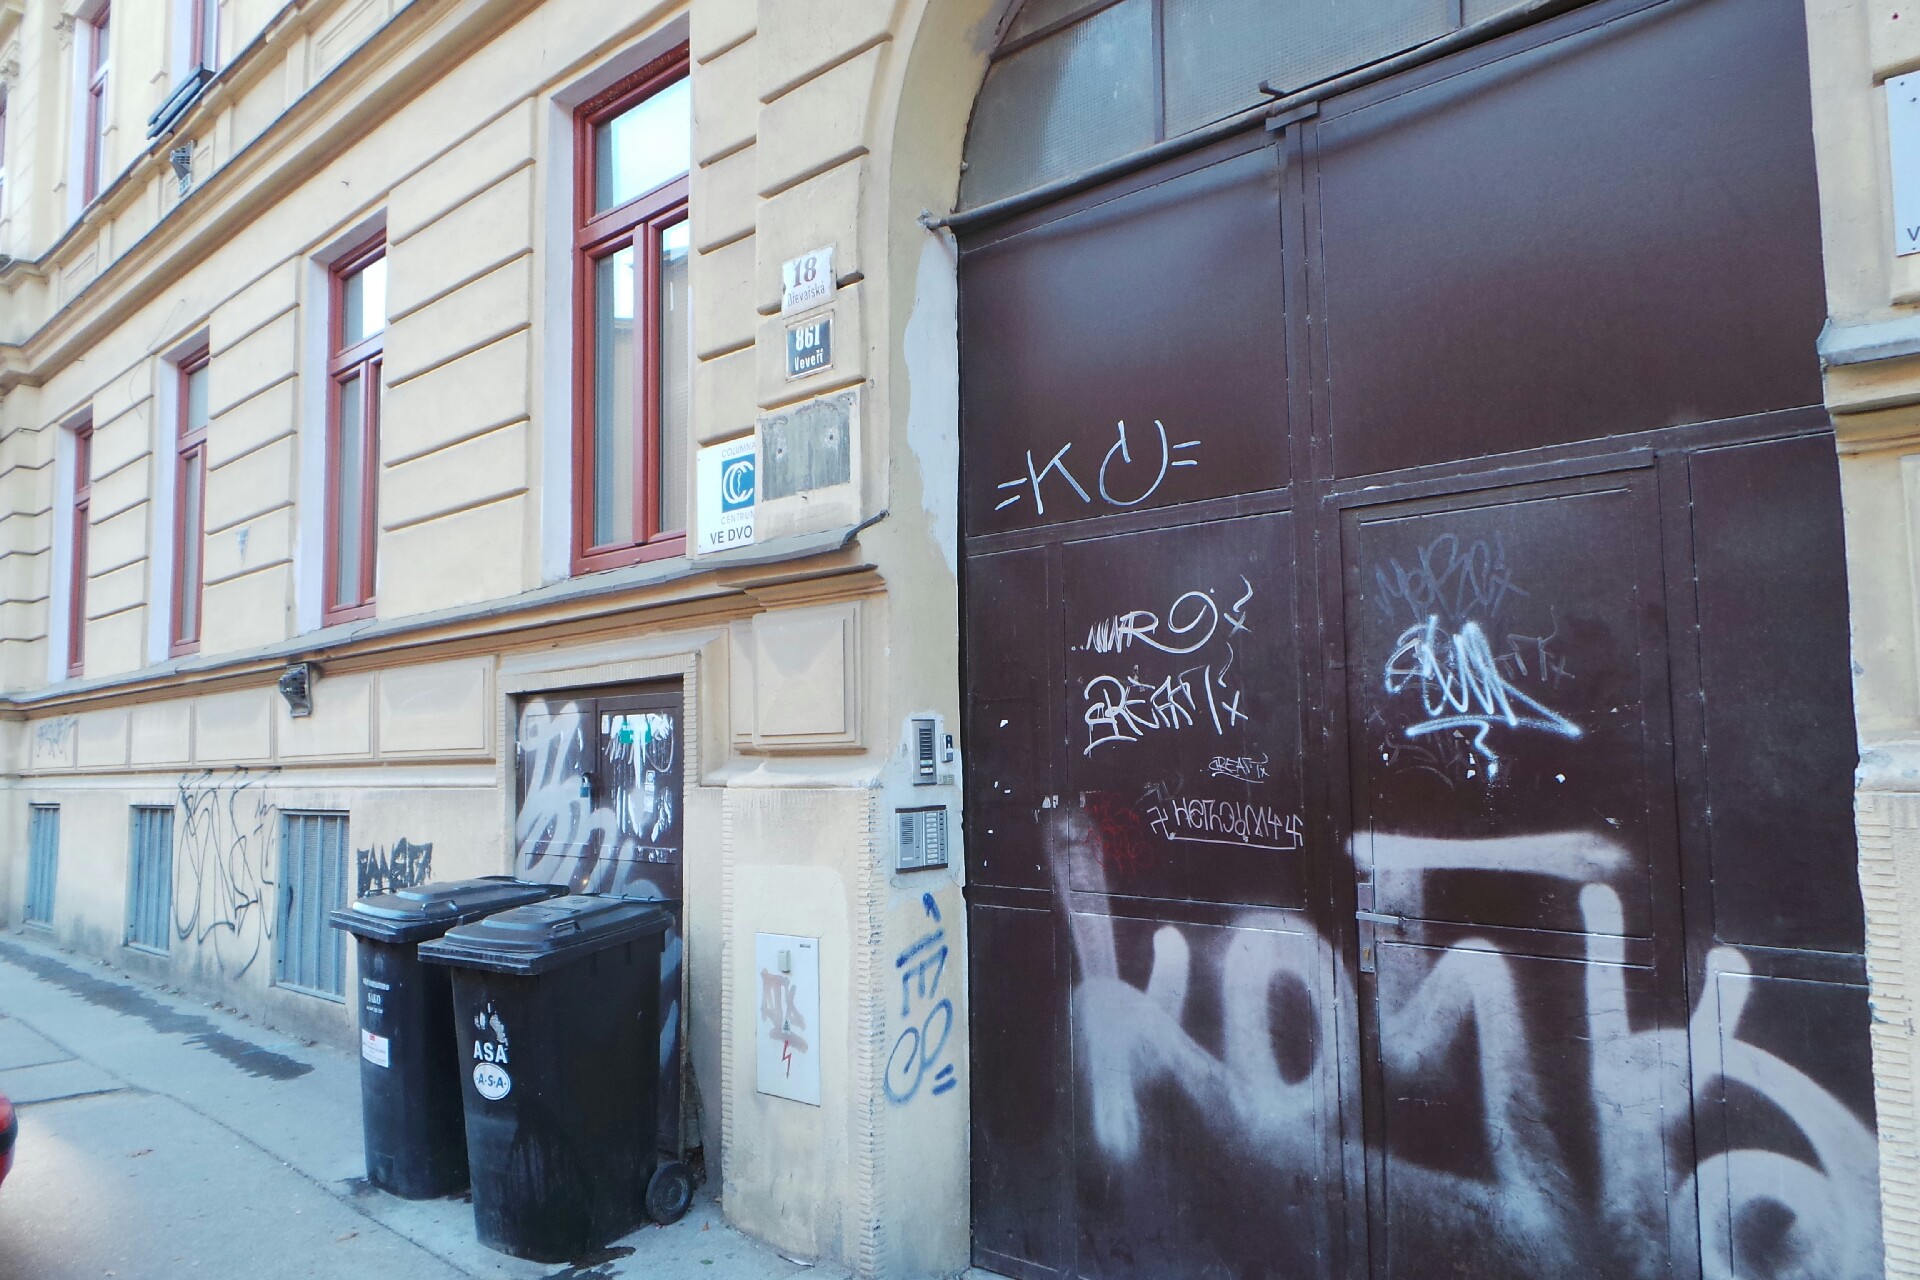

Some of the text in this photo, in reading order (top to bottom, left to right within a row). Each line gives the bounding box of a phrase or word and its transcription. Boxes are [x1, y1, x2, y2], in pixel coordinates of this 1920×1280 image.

[793, 256, 818, 288] 18
[795, 323, 821, 351] 861
[794, 347, 824, 371] Veveří
[710, 530, 724, 546] VE
[473, 1040, 508, 1064] ASA
